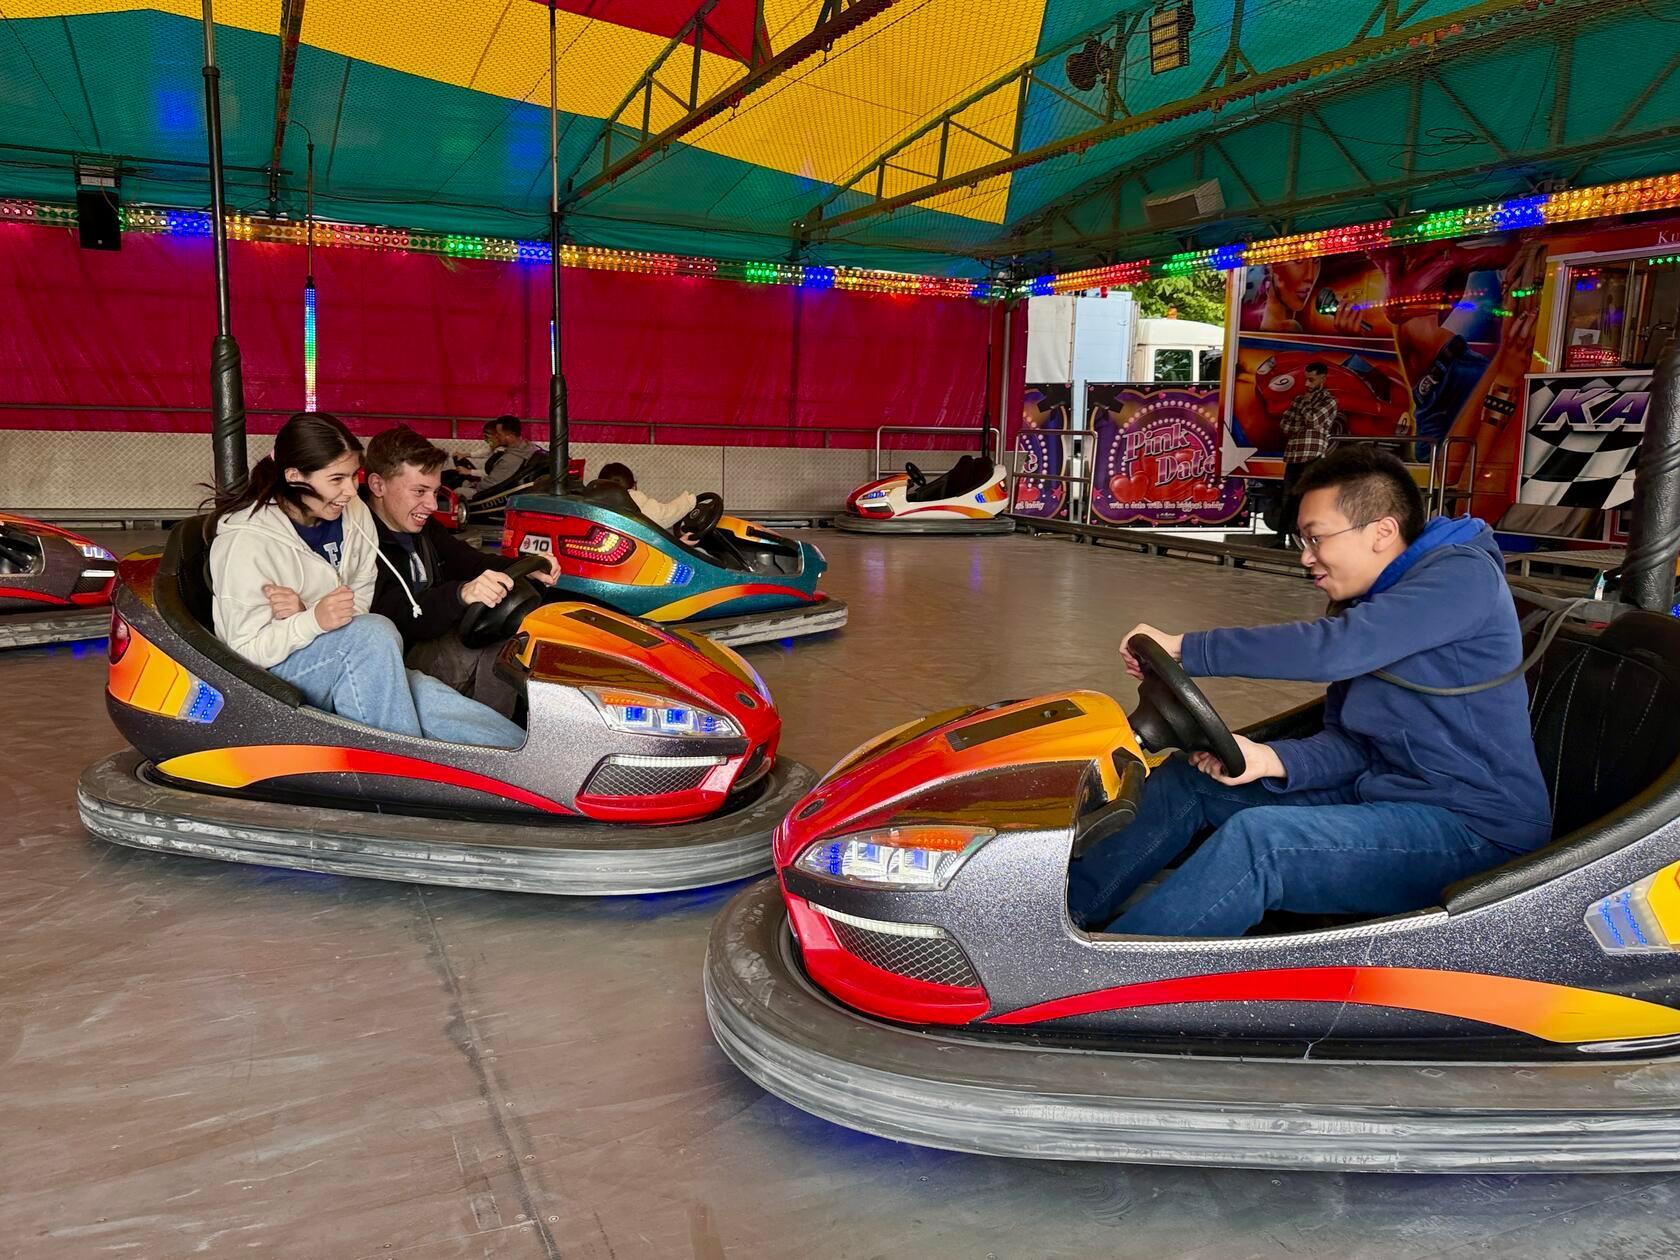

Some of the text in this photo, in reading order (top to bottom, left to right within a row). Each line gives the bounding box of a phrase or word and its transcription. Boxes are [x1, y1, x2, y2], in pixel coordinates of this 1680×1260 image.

[1122, 422, 1190, 463] Pink
[1154, 449, 1215, 487] Date
[1147, 501, 1163, 509] with
[1164, 501, 1175, 509] the
[532, 539, 550, 552] 10
